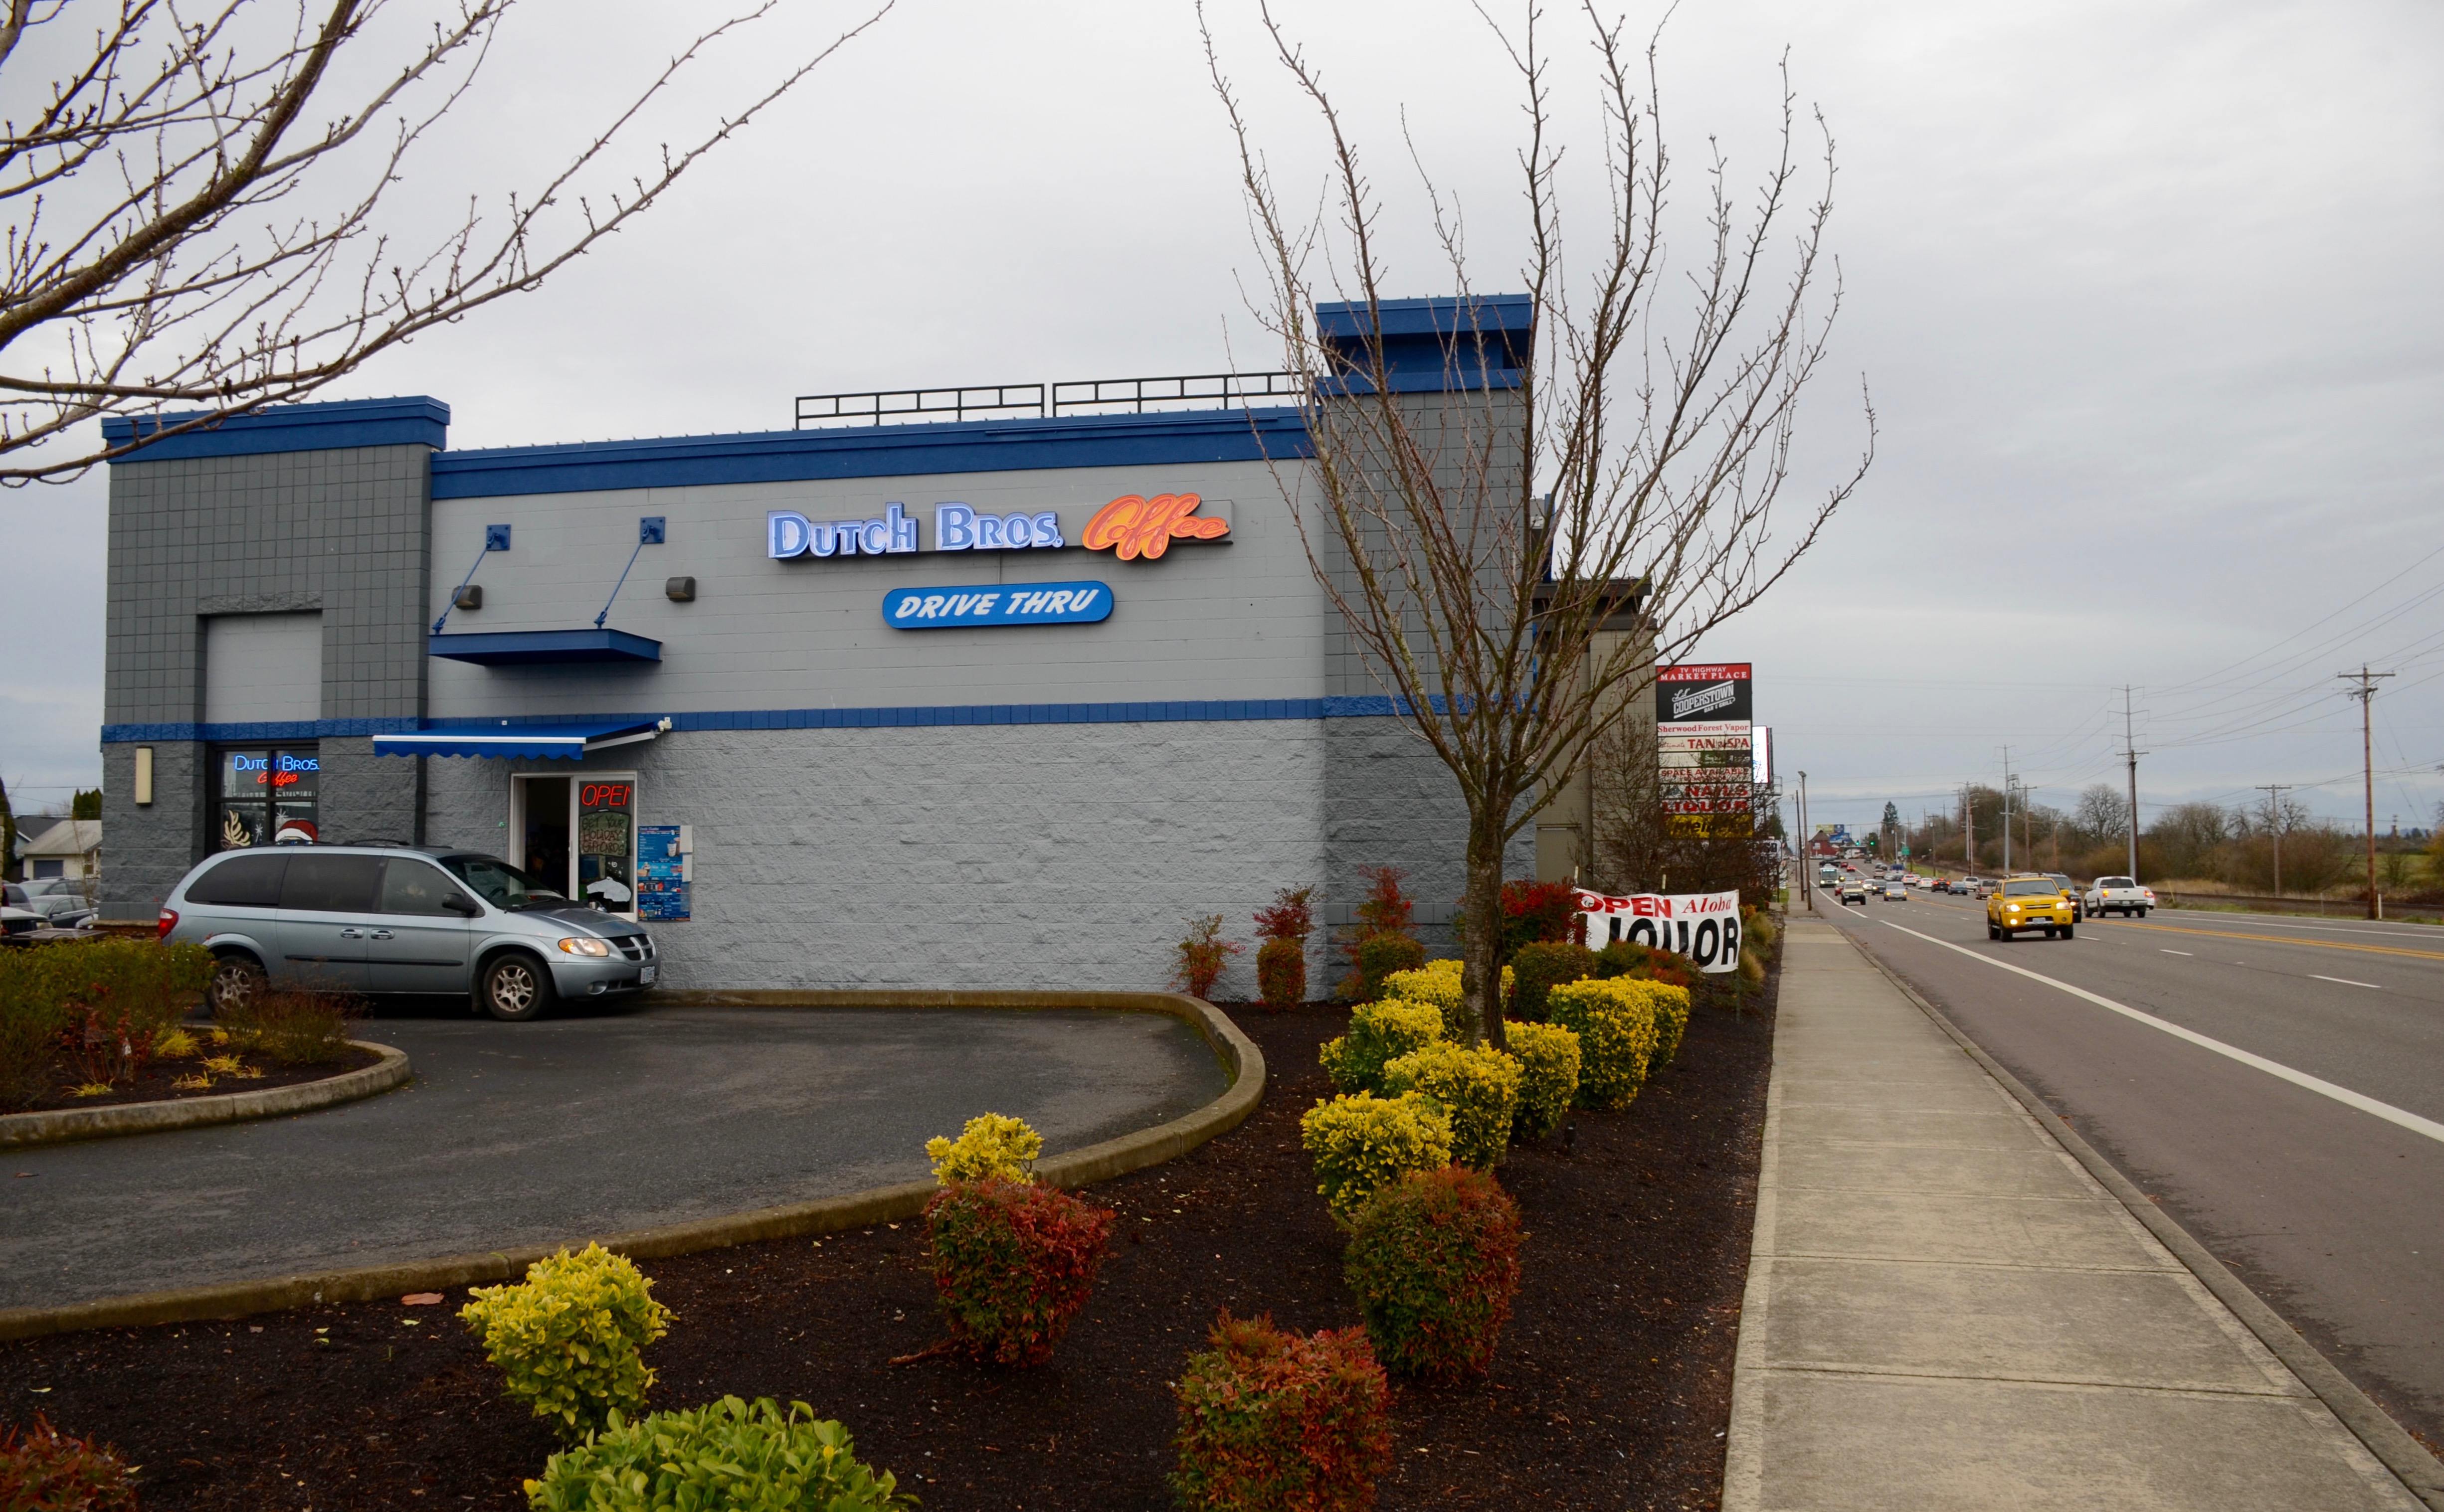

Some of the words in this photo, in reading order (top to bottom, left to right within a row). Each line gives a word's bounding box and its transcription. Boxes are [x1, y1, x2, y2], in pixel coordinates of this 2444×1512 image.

[1082, 493, 1230, 560] Coffee
[895, 593, 999, 618] DRIVE
[1005, 588, 1099, 615] THRU
[1673, 684, 1734, 714] COOPERSTOWN
[1719, 699, 1733, 708] GRILL
[1724, 724, 1749, 733] Vapor
[1688, 738, 1715, 749] TAN
[1727, 738, 1749, 748] SPA
[1685, 785, 1748, 797] NAILS
[1662, 800, 1748, 813] LIQUOR
[582, 816, 603, 830] GET
[605, 815, 625, 829] YOUR
[1578, 893, 1672, 918] OPEN
[1681, 896, 1731, 913] Aloha
